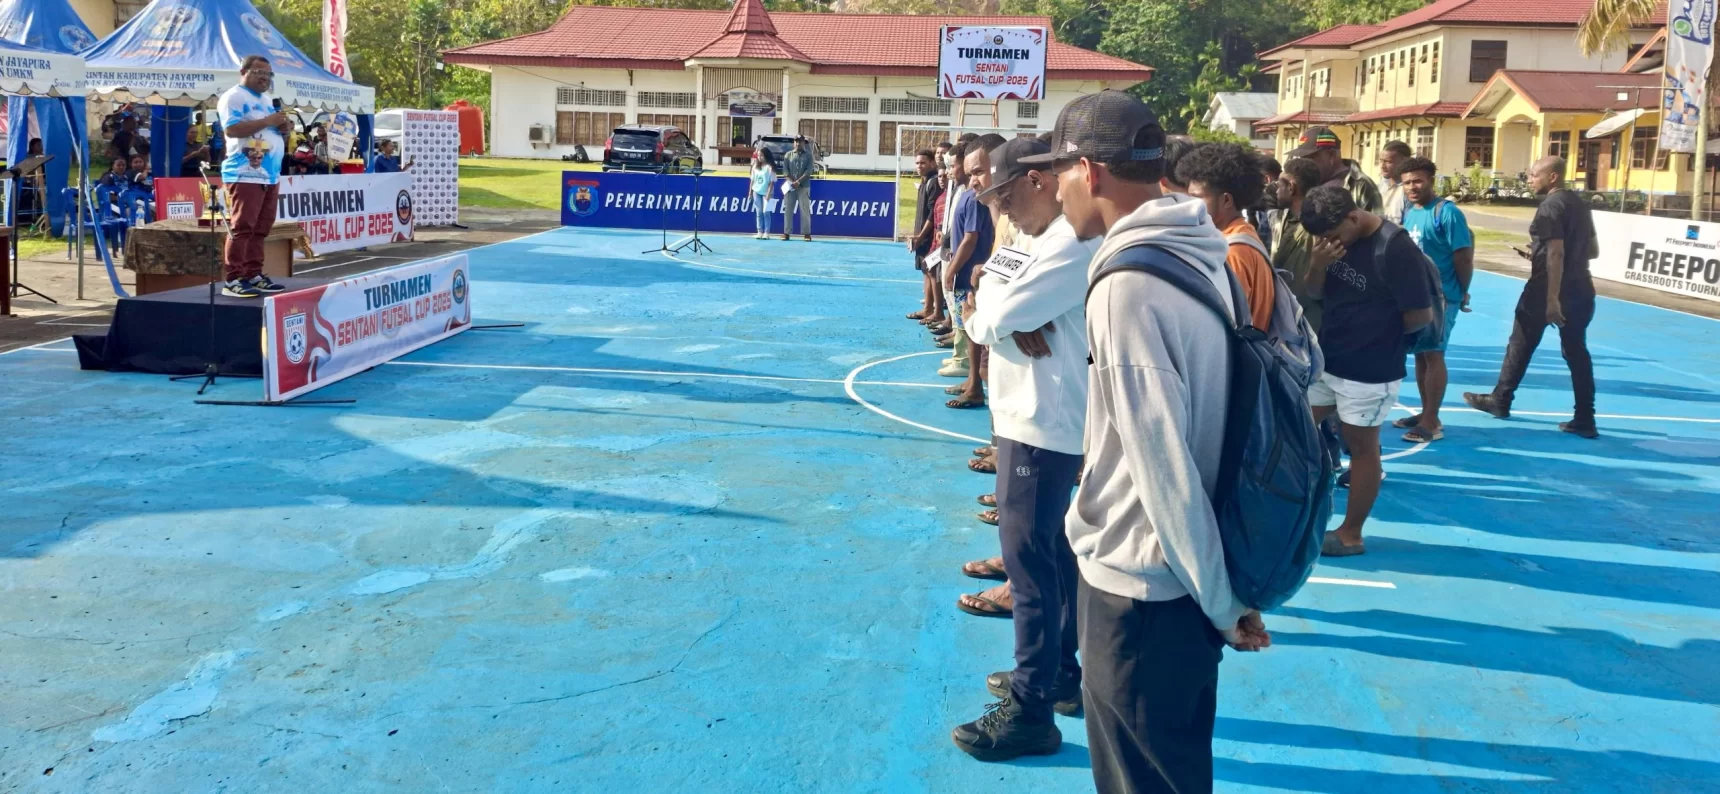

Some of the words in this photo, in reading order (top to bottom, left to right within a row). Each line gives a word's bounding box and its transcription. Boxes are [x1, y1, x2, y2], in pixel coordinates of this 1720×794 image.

[957, 47, 1030, 60] TURNAMEN
[6, 56, 51, 70] JAYAPURA
[976, 63, 1009, 73] SENTANI
[6, 67, 34, 79] UMKM
[117, 72, 168, 81] KABUPATEN
[170, 73, 215, 82] JAYAPURA
[955, 75, 985, 84] FUTSAL
[988, 76, 1004, 85] CUP
[1006, 76, 1028, 85] 2025
[169, 81, 196, 90] UMKM
[279, 190, 365, 219] TURNAMEN
[605, 192, 703, 211] PEMERINTAH
[345, 215, 365, 240] CUP
[368, 212, 393, 236] 2025
[1627, 241, 1720, 284] FREEPO
[1624, 270, 1683, 290] GRASSROOTS
[364, 273, 432, 311] TURNAMEN
[337, 314, 379, 347] SENTANI
[381, 305, 413, 330] FUTSAL
[415, 300, 431, 321] CUP
[432, 291, 452, 315] 2025
